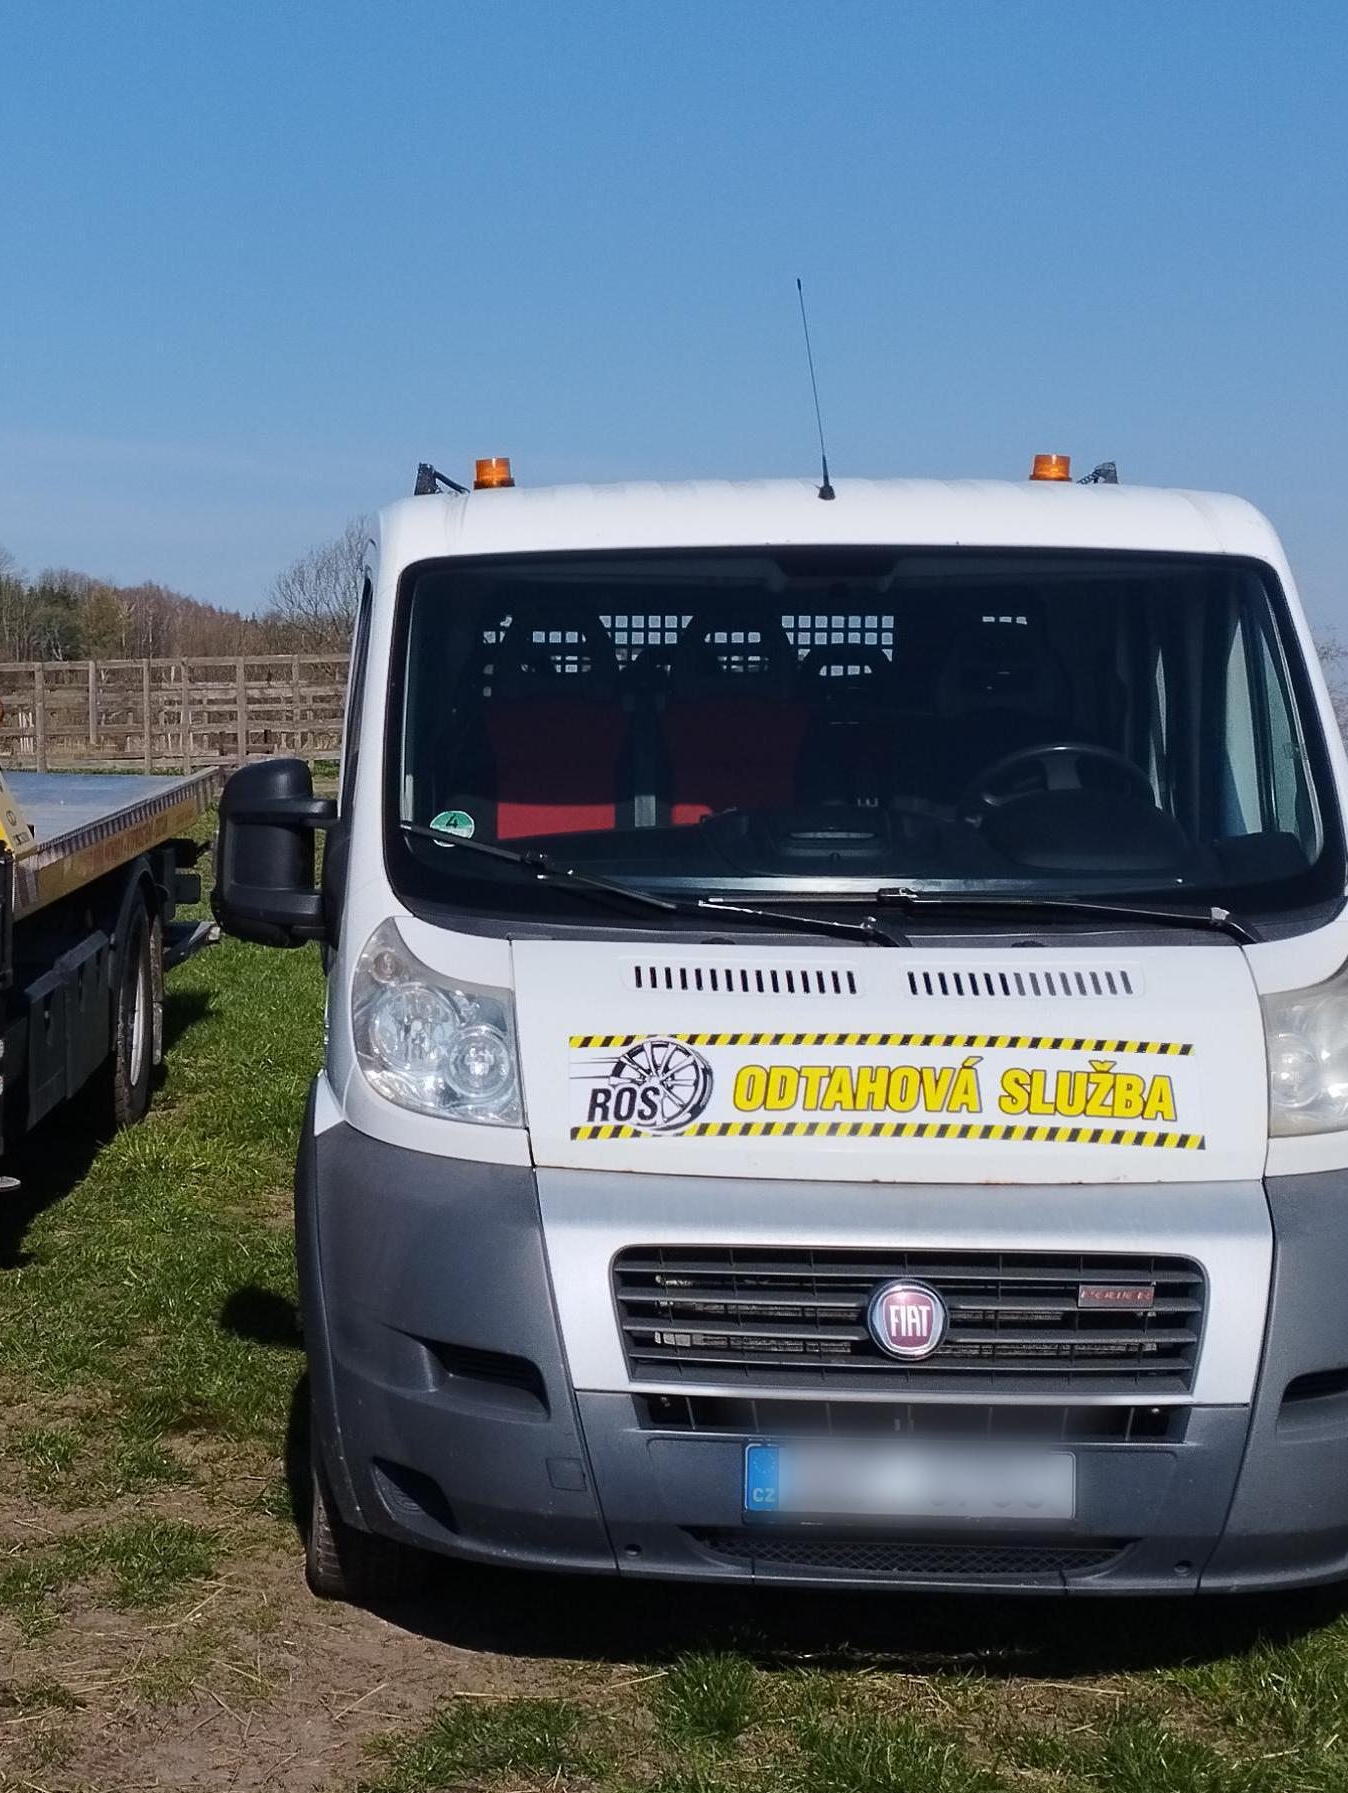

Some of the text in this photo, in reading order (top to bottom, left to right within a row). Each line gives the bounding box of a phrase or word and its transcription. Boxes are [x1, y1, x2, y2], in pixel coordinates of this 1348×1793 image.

[446, 813, 458, 828] 4
[587, 1086, 661, 1123] ROS
[733, 1056, 1178, 1122] ODTAHOVÁ SLUŽBA
[889, 1305, 931, 1337] FIAT
[753, 1488, 776, 1503] CZ
